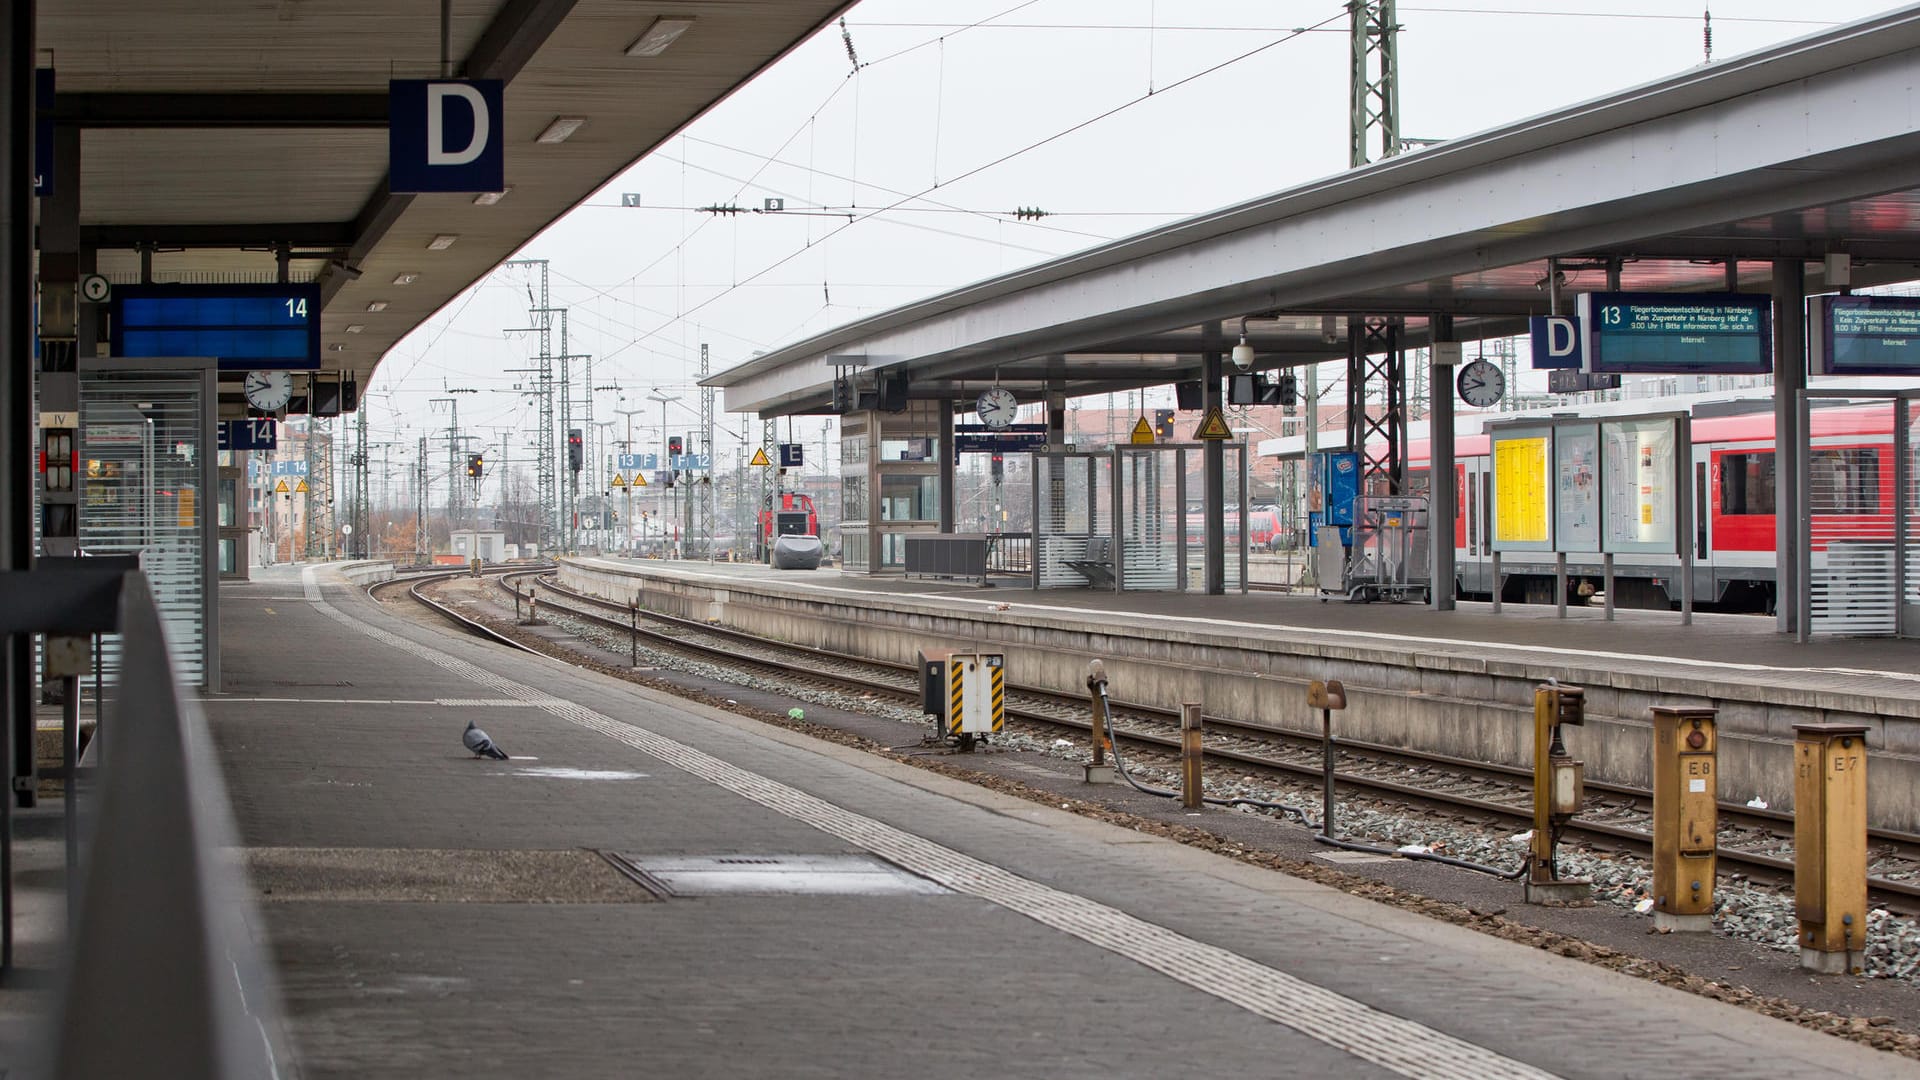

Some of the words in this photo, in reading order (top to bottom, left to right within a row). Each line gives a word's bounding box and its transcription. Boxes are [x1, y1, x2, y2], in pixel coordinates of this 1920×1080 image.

[427, 83, 490, 166] D
[285, 298, 308, 318] 14
[1602, 306, 1621, 325] 13
[1652, 314, 1687, 322] Zugverkehr
[1698, 315, 1725, 323] Nürnberg
[1546, 318, 1576, 357] D
[54, 414, 66, 425] IV
[247, 421, 273, 443] 14
[620, 455, 634, 467] 13
[643, 455, 652, 466] F
[678, 455, 686, 467] F
[695, 455, 710, 467] 12
[790, 444, 801, 462] E
[276, 461, 285, 473] F
[294, 461, 307, 473] 14
[1713, 464, 1718, 482] 2
